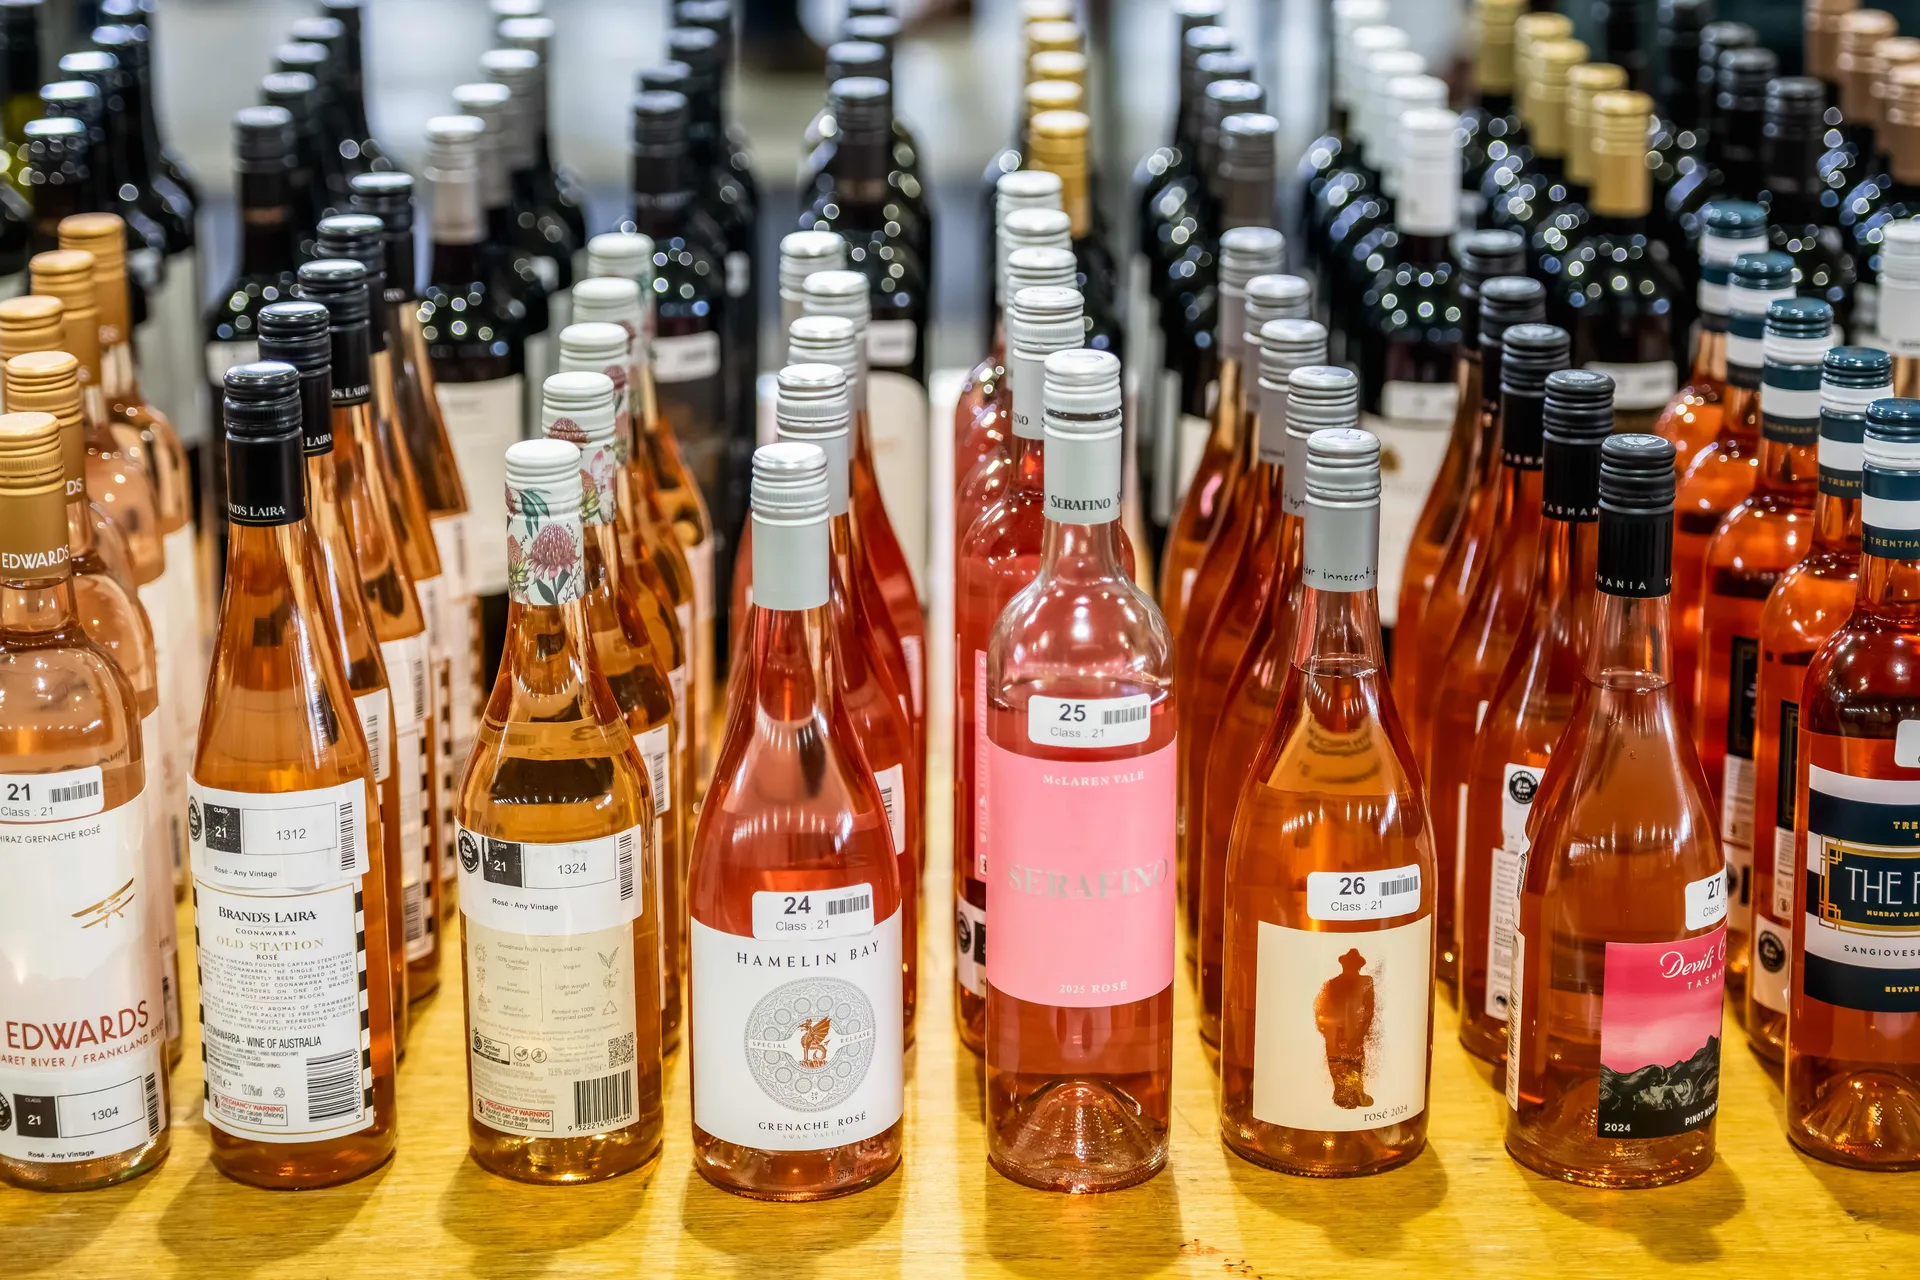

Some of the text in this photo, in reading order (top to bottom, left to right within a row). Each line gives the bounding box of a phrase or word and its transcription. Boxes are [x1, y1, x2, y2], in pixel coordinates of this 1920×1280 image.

[306, 432, 332, 447] LAIRA
[250, 505, 286, 517] LAIRA
[1051, 495, 1111, 511] SERAFINO
[2, 544, 69, 569] EDWARDS
[1323, 565, 1370, 582] innocent
[1059, 703, 1086, 722] 25
[1050, 726, 1104, 738] Class 21
[1043, 770, 1145, 786] McLAREN VALE
[7, 783, 31, 801] 21
[0, 806, 53, 817] Class 21
[24, 831, 76, 844] GRENACHE
[78, 824, 101, 837] ROSÉ
[215, 825, 306, 841] 21 1312
[213, 866, 278, 878] Rosé Any Vintage
[493, 860, 587, 875] 21 1324
[1008, 858, 1168, 899] SERAFINO
[1339, 877, 1366, 896] 26
[1845, 866, 1902, 905] THE
[1708, 877, 1721, 900] 27
[492, 898, 559, 912] Rosé Any Vintage
[783, 895, 812, 915] 24
[1330, 900, 1383, 912] Class 21
[1703, 902, 1720, 918] Class
[218, 906, 317, 923] BRAND'S LAIRA
[235, 927, 297, 936] COONAWARRA
[776, 919, 830, 931] Class 21
[216, 935, 326, 952] OLD STATION
[737, 940, 880, 968] HAMELIN BAY
[1659, 945, 1715, 979] Devil's
[298, 972, 326, 980] OPENED
[1059, 981, 1128, 993] 2025 ROSÉ
[6, 1000, 149, 1051] EDWARDS
[246, 1037, 265, 1048] WINE
[267, 1038, 277, 1049] OF
[279, 1036, 322, 1049] AUSTRALIA
[752, 1041, 787, 1049] SPECIAL
[840, 1031, 871, 1043] RELEASE
[30, 1057, 65, 1067] RIVER
[83, 1034, 149, 1064] FRANKLAND
[27, 1106, 119, 1125] 21 1304
[485, 1100, 550, 1118] PREGNANCY WARNING
[1363, 1104, 1409, 1122] rosé 2024
[577, 1122, 604, 1131] 322214
[758, 1111, 867, 1131] GRENACHE ROSÉ
[1684, 1112, 1705, 1126] PINOT
[1603, 1122, 1632, 1133] 2024
[51, 1151, 65, 1160] Any
[67, 1150, 95, 1158] Vintage
